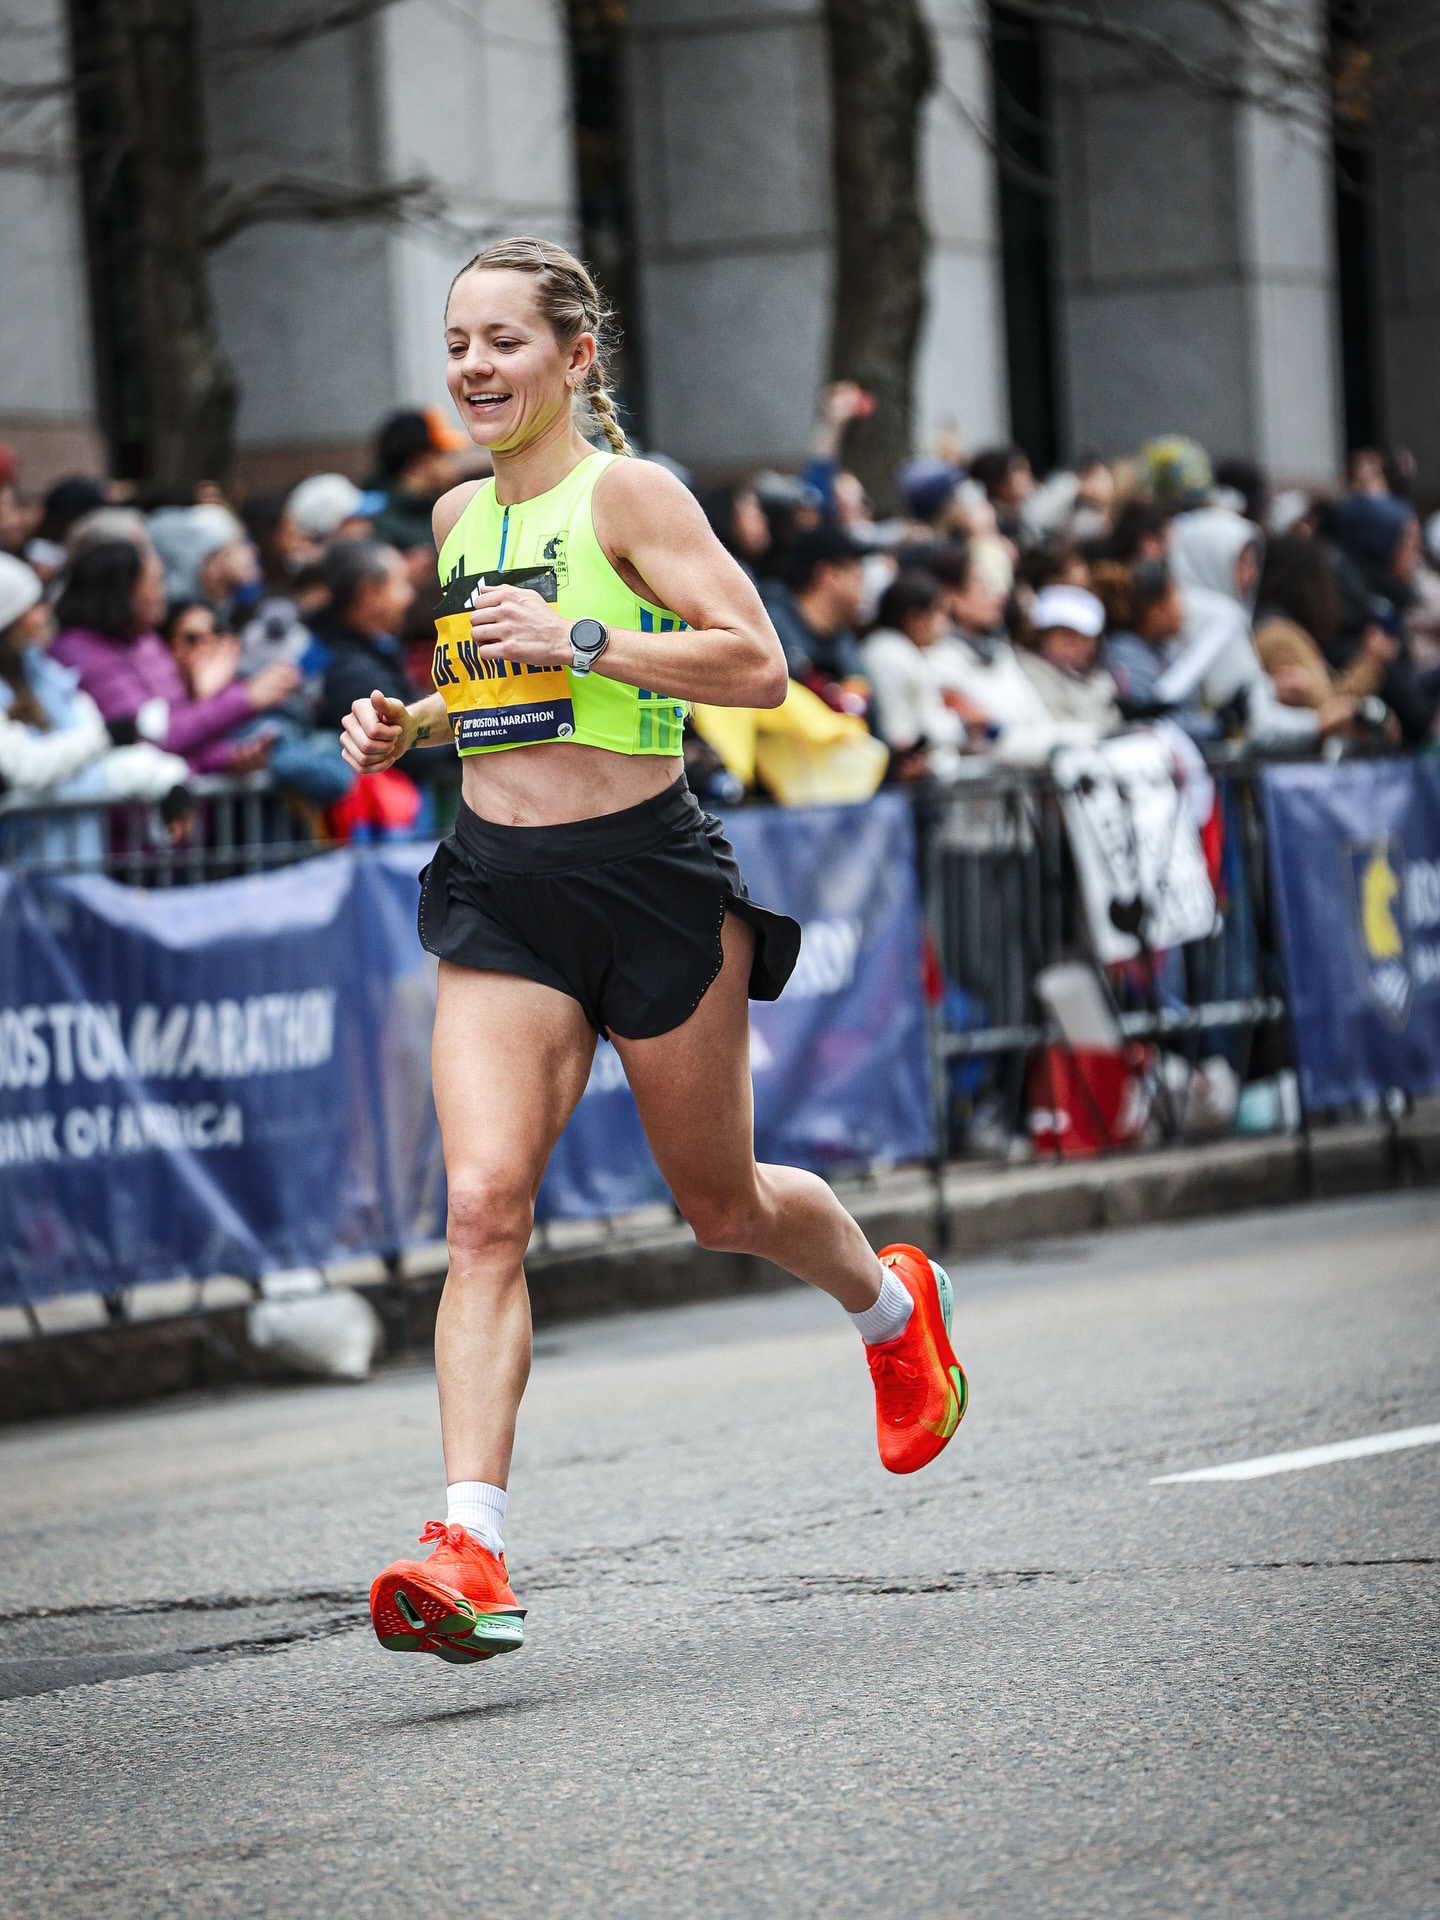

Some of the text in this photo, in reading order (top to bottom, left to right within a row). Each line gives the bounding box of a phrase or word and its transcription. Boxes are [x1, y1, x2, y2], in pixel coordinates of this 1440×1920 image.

[433, 643, 461, 687] DE
[472, 716, 500, 728] BOSTON
[500, 710, 555, 726] MARATHON
[480, 729, 508, 737] AMERICA
[0, 986, 337, 1090] OSTON MARATHO
[0, 1098, 244, 1168] ANK OF AICA
